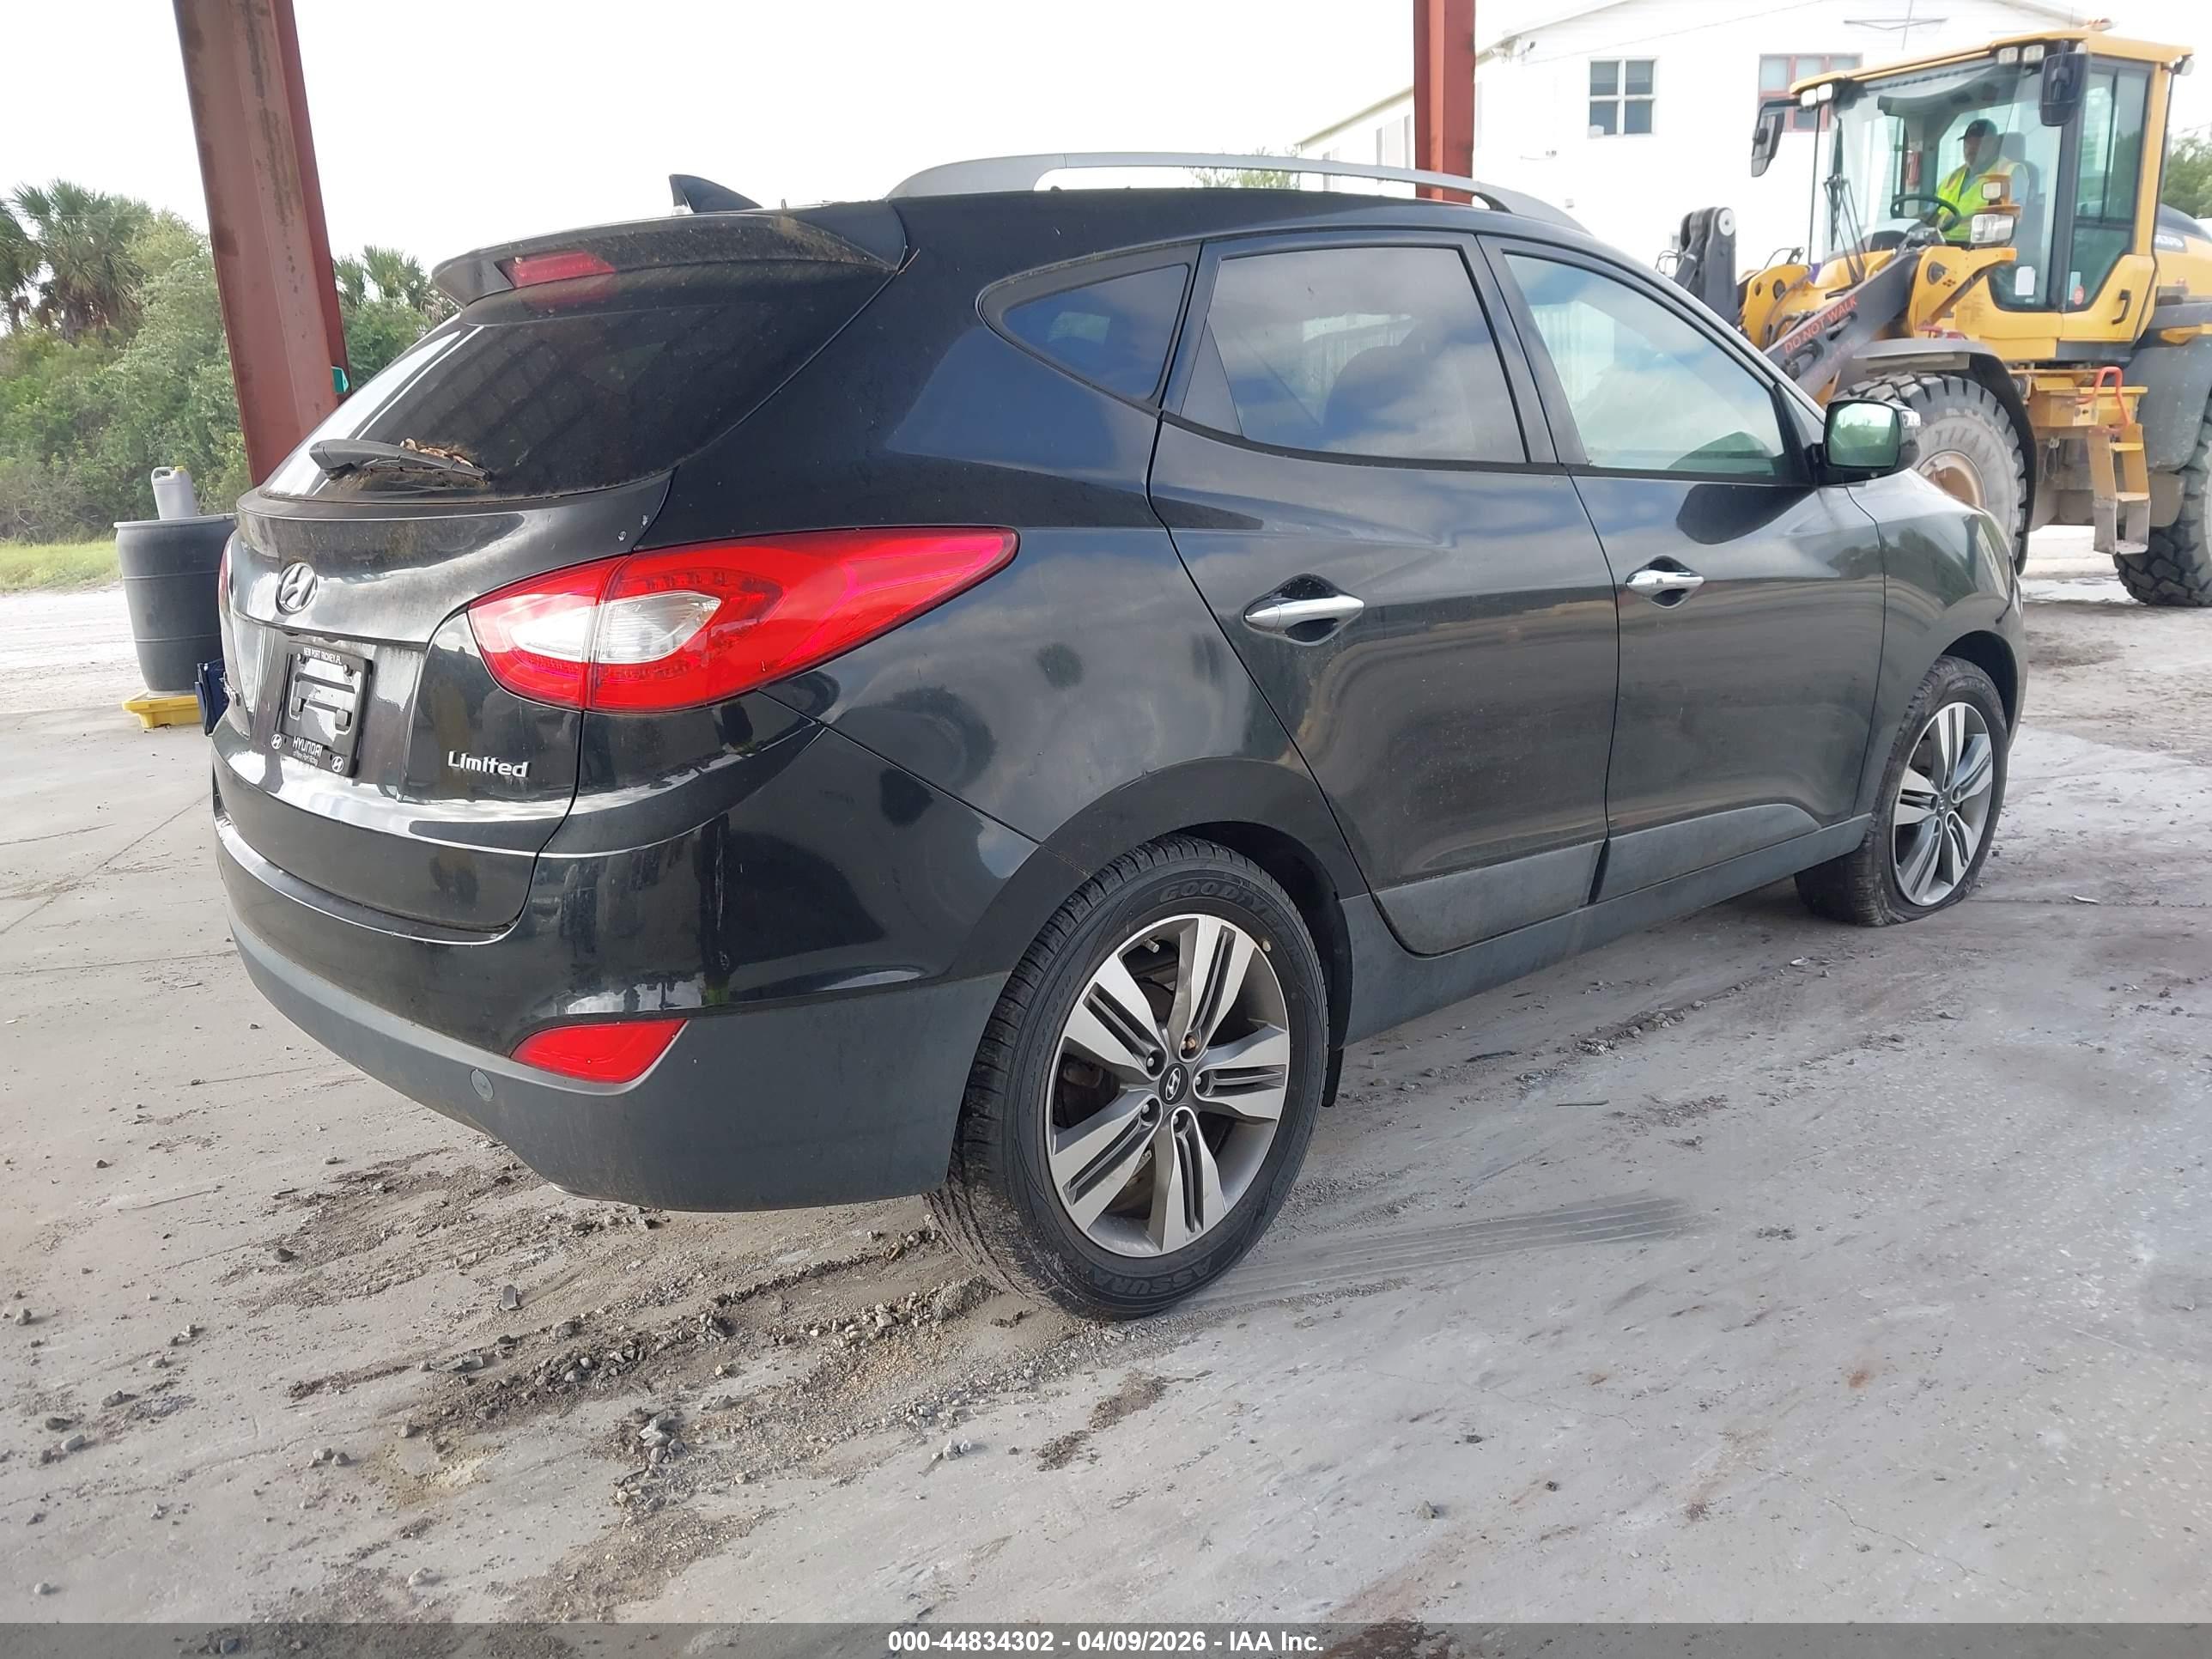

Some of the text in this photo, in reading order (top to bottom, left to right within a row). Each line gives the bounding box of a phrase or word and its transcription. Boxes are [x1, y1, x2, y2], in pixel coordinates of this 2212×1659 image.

[1784, 295, 1857, 354] DO NOT WALK
[292, 735, 324, 758] HYUNDAI
[447, 750, 529, 778] Limited
